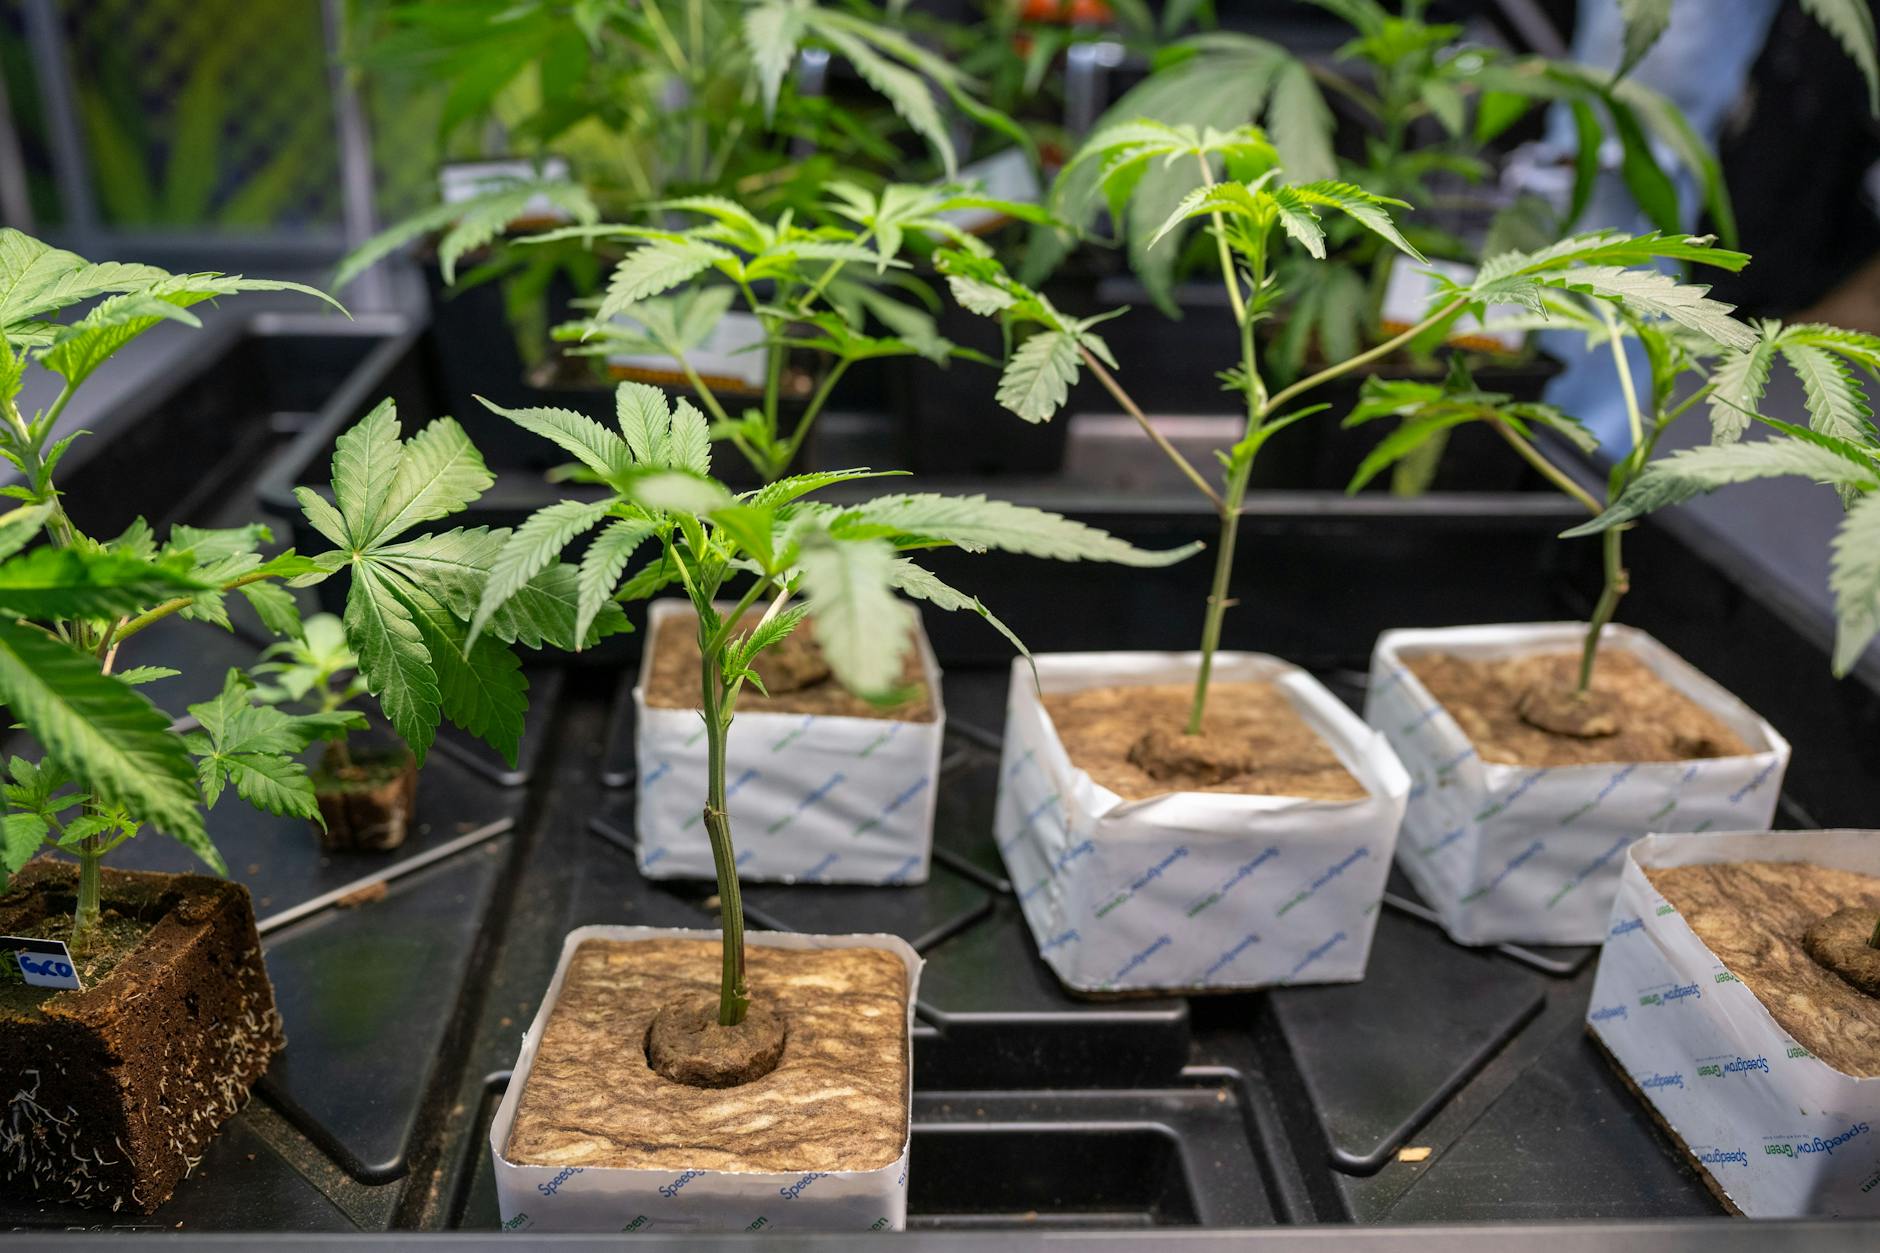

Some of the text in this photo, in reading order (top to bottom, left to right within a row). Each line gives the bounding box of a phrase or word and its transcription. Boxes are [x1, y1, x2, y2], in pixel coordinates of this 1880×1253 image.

[1697, 1063, 1723, 1078] Green
[1724, 1055, 1769, 1077] Speedgrow
[1764, 1122, 1870, 1158] Speedgrow Green
[1701, 1147, 1748, 1168] Speedgrow
